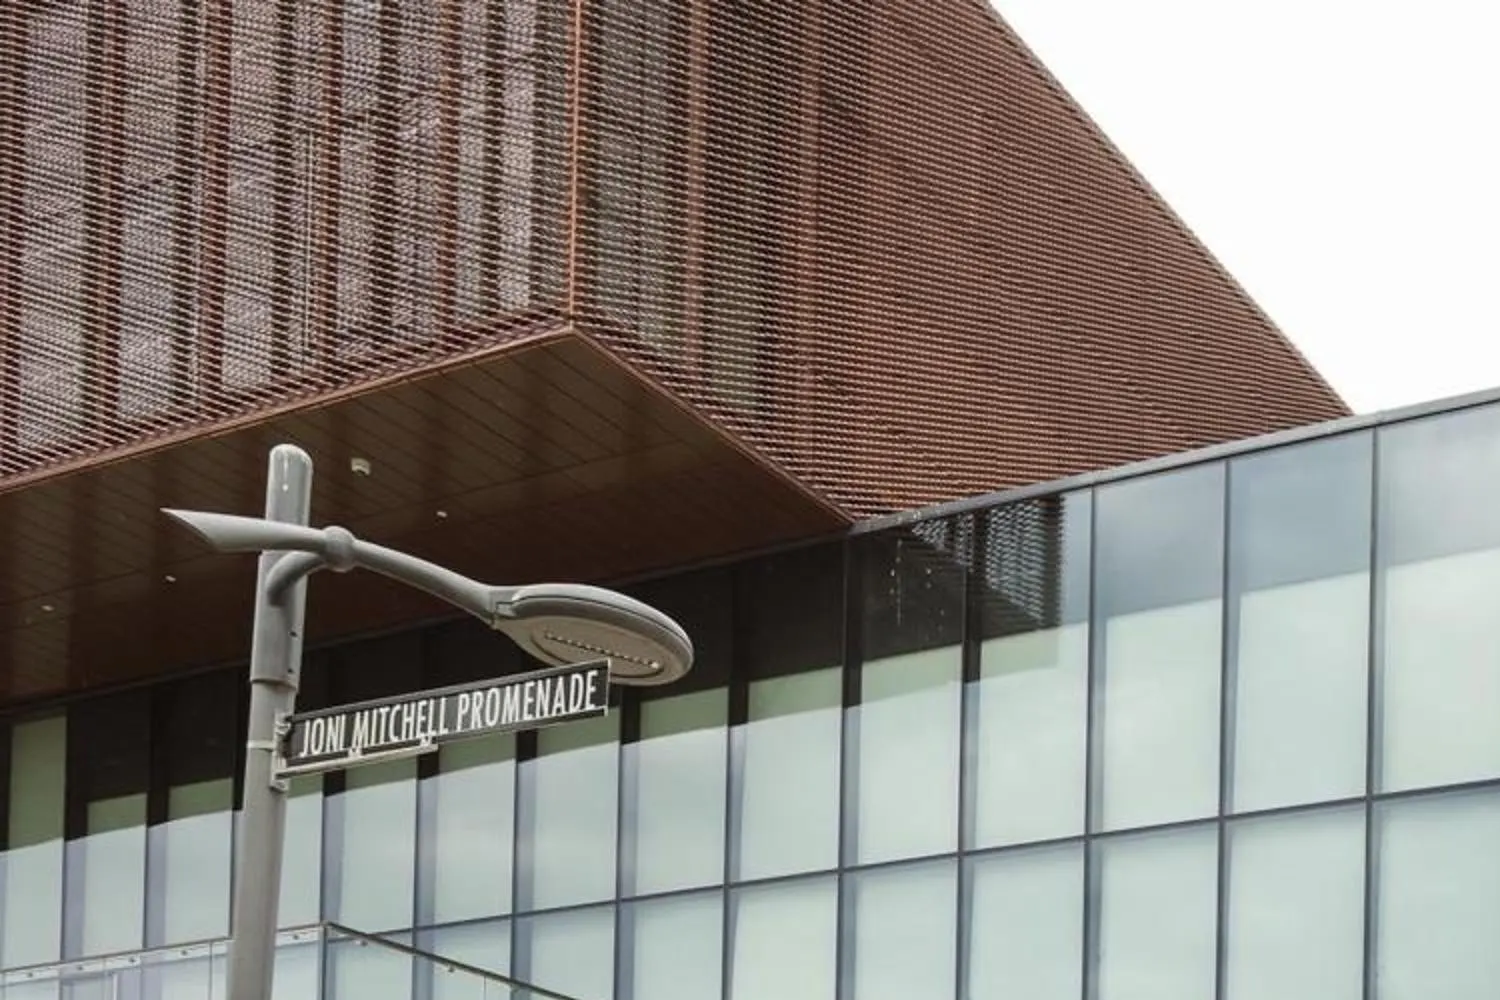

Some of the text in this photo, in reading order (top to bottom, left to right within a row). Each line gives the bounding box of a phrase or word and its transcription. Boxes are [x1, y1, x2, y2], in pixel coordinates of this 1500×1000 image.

[300, 670, 599, 758] JONI MITCHELL PROMENADE
